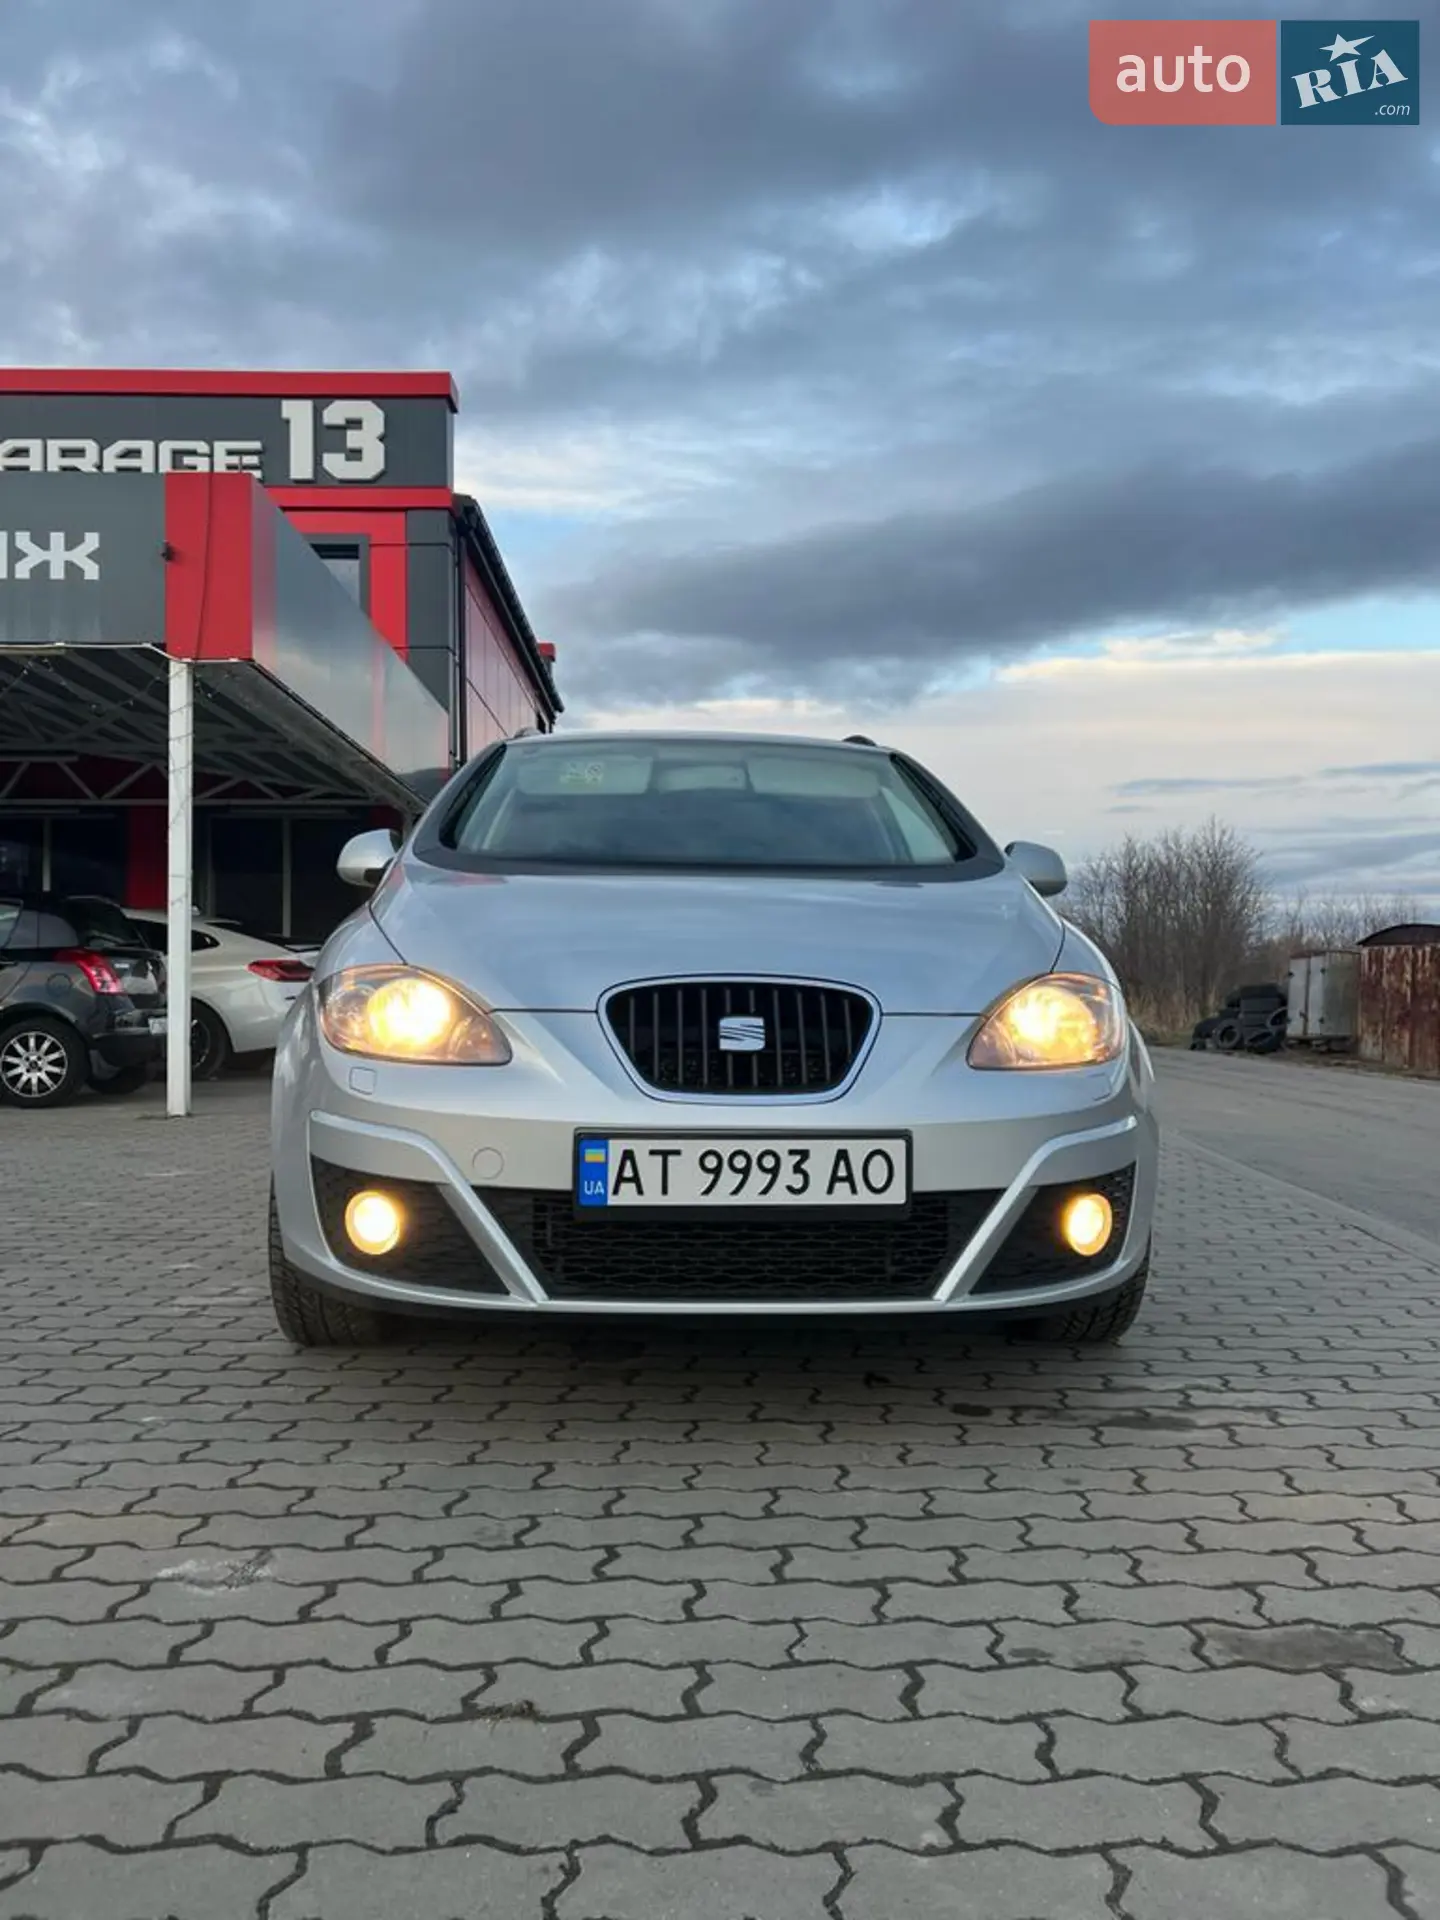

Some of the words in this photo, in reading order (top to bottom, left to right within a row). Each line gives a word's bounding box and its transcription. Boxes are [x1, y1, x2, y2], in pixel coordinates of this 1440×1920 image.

[281, 399, 386, 480] 13
[0, 531, 100, 580] Ж
[583, 1180, 605, 1196] UA
[612, 1149, 682, 1196] AT
[698, 1148, 810, 1196] 9993
[826, 1148, 895, 1195] AO
